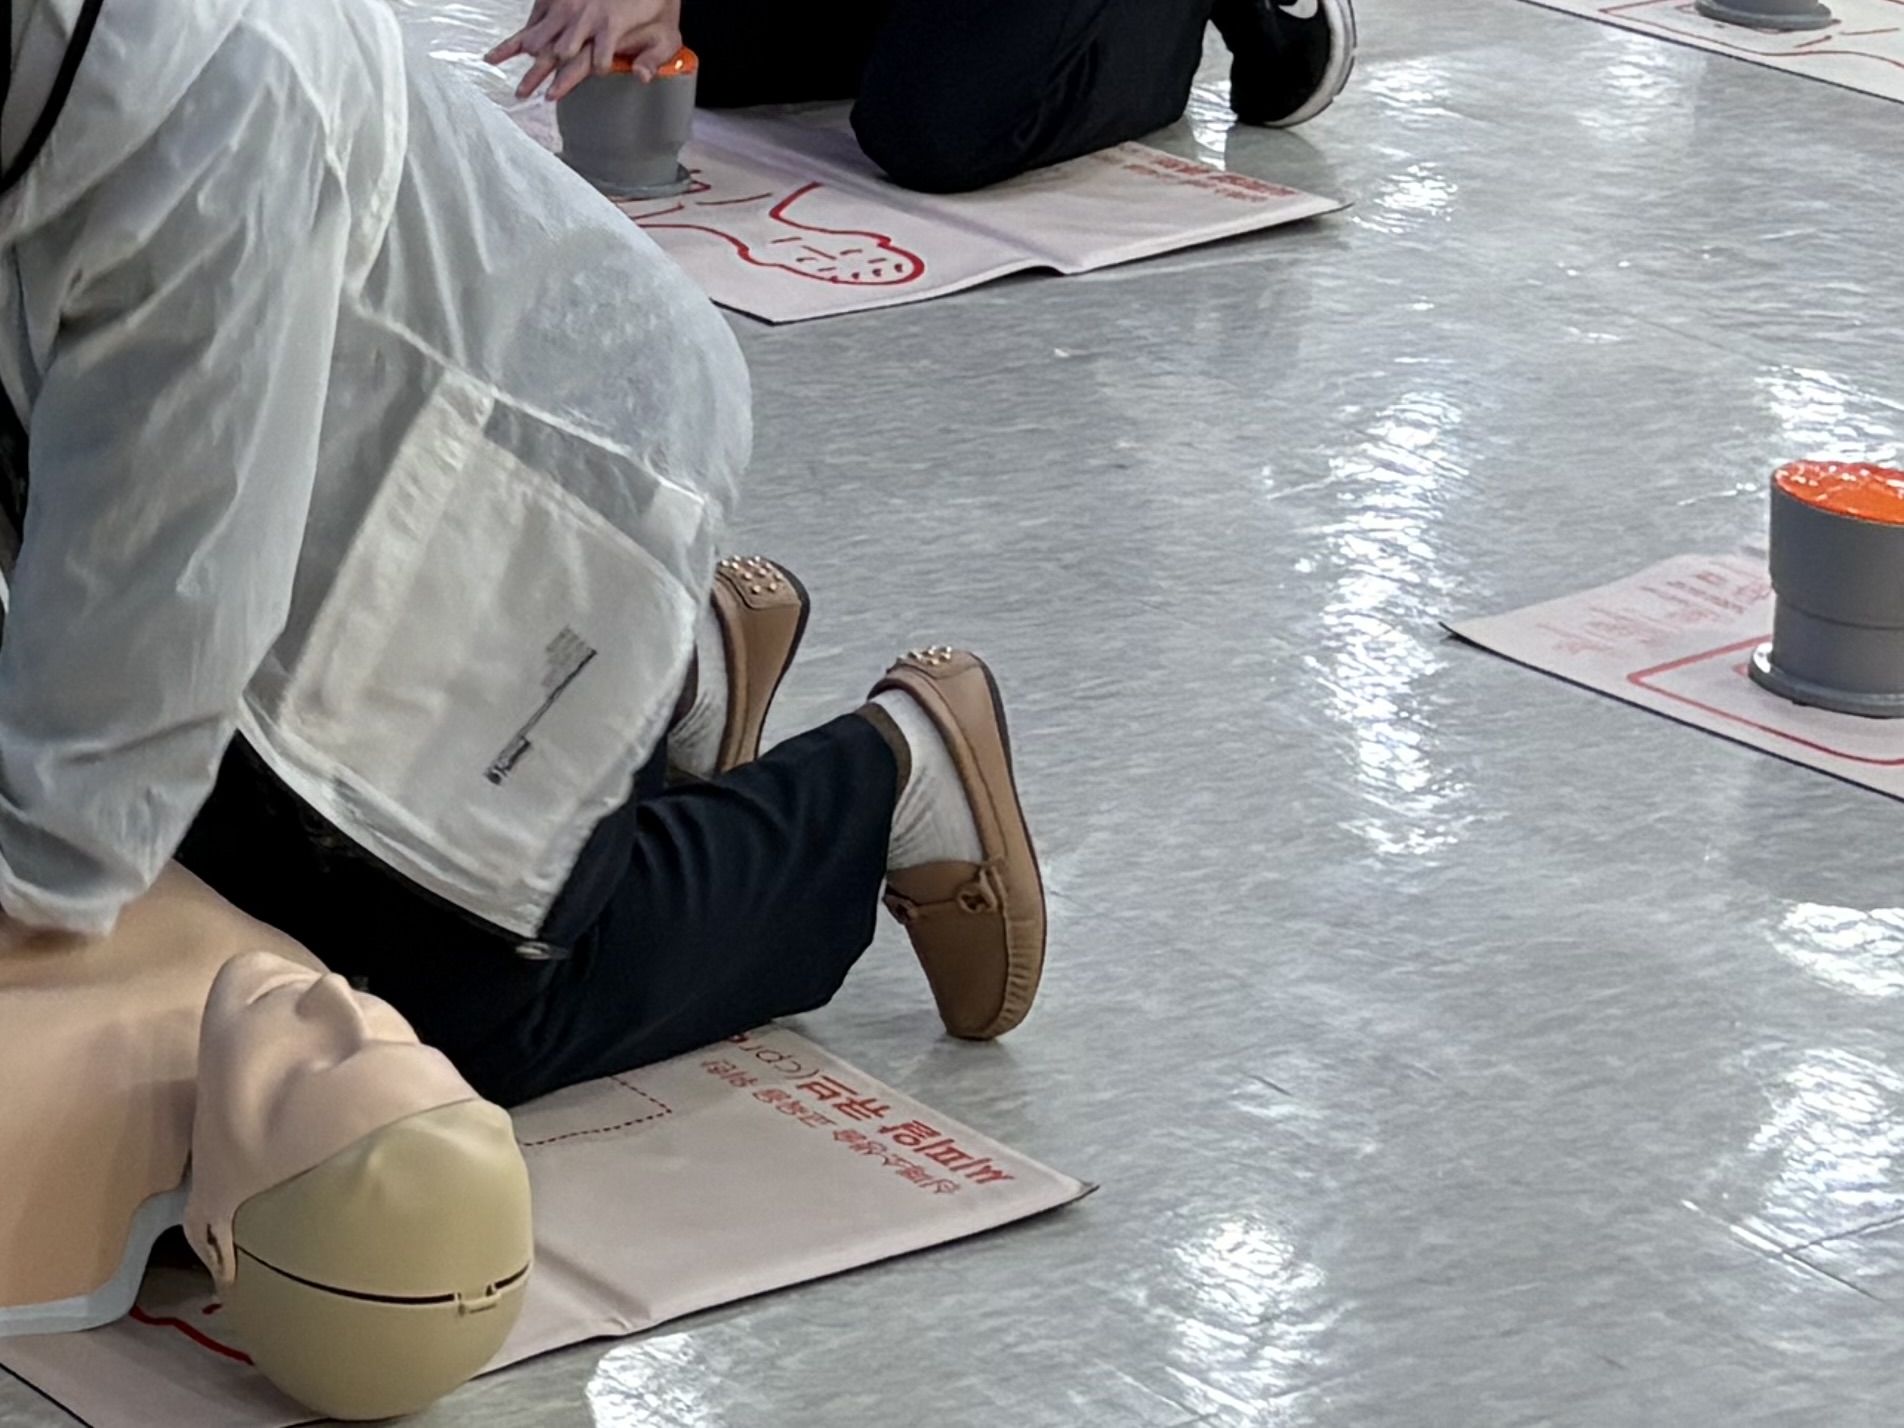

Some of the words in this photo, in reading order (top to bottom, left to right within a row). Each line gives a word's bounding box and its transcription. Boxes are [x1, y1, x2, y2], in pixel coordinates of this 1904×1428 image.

[701, 1059, 759, 1088] 위한
[752, 1088, 838, 1129] 교육을
[832, 1129, 961, 1194] 심폐소생술
[878, 1119, 1017, 1184] 씨피알
